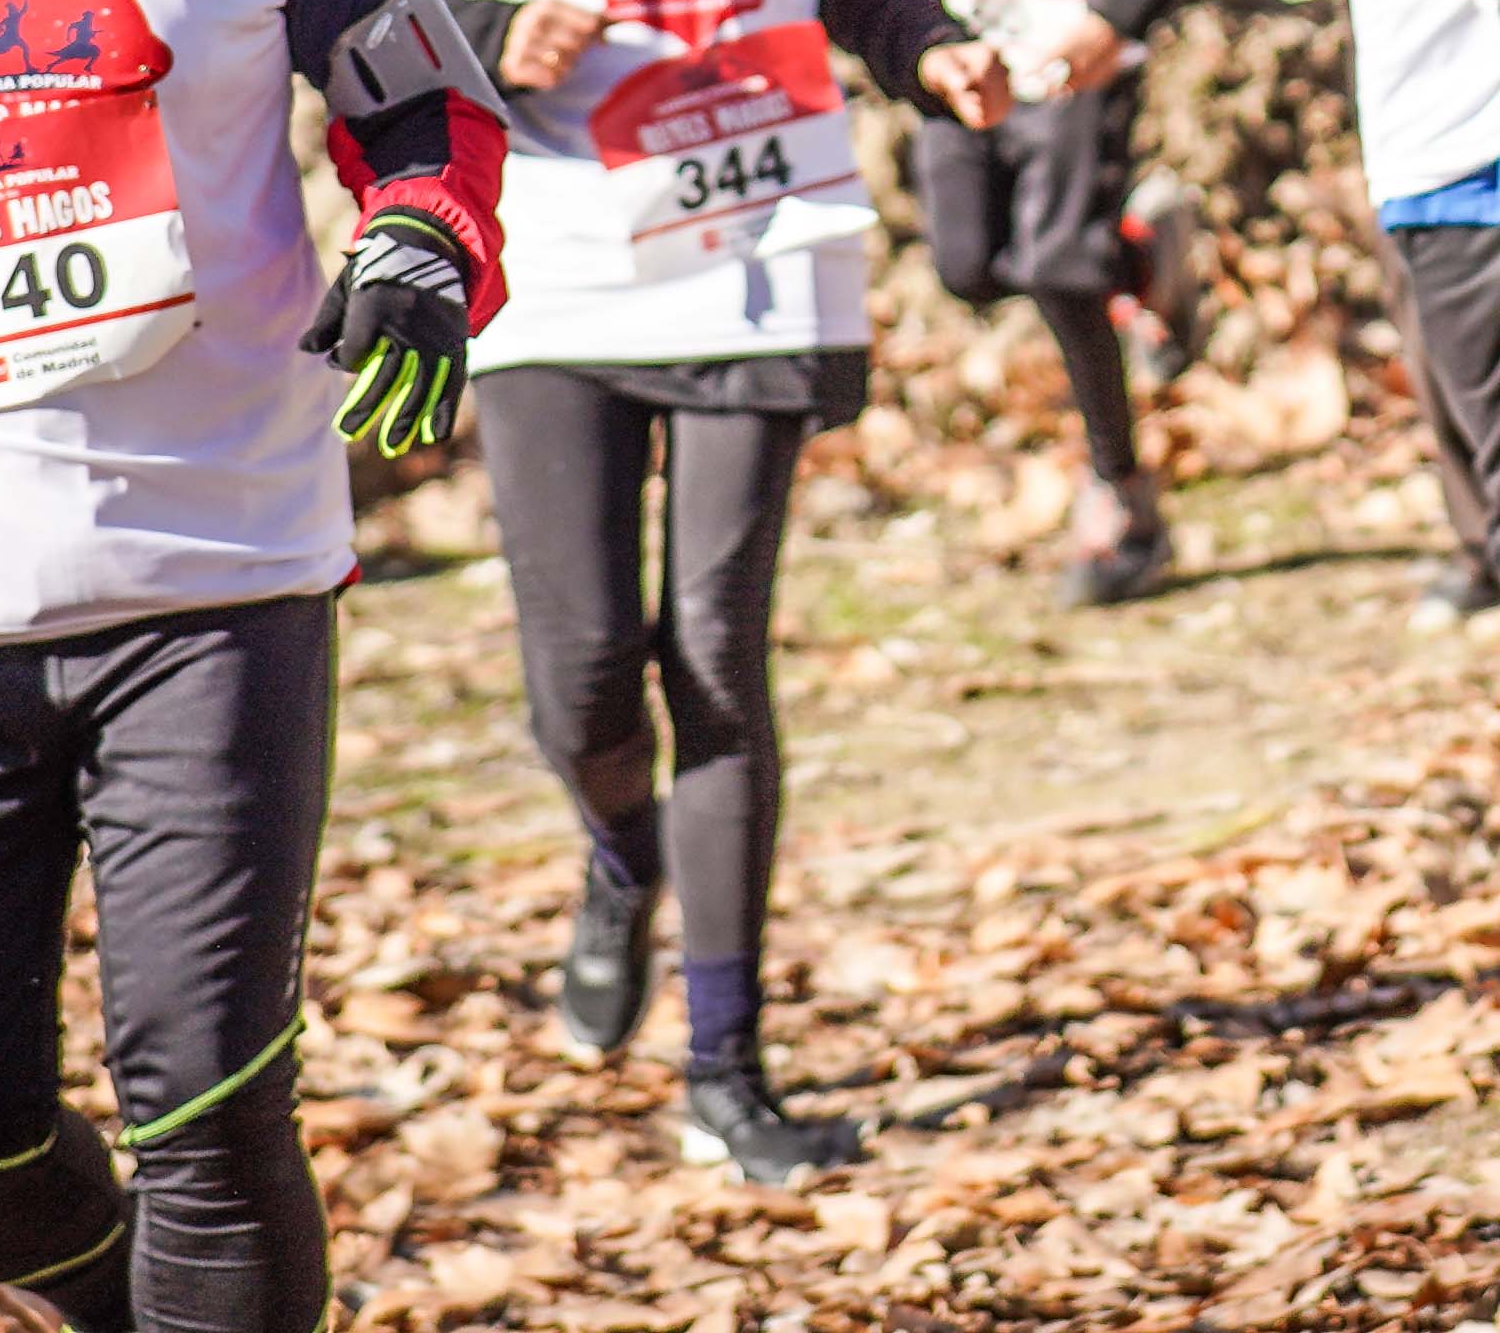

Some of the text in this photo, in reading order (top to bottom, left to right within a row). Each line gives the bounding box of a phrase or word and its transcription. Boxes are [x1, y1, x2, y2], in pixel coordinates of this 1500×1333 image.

[18, 73, 102, 90] POPULAR
[676, 135, 791, 210] 344
[8, 181, 113, 239] MAGOS
